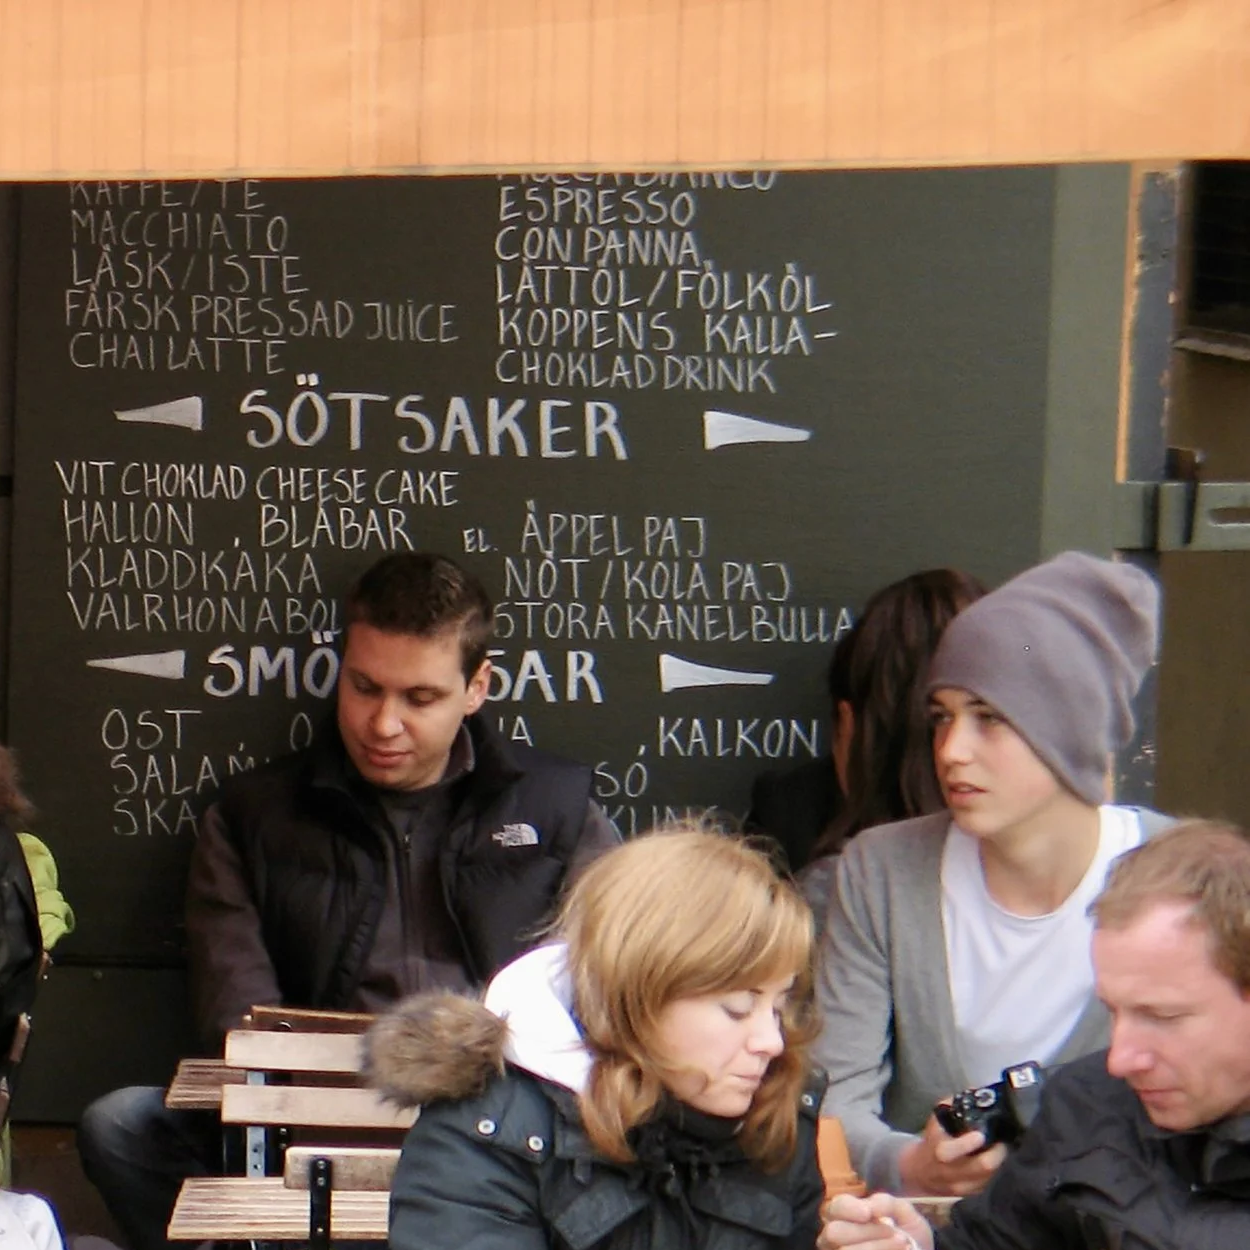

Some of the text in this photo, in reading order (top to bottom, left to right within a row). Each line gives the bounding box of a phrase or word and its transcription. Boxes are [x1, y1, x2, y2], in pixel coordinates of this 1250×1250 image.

[498, 187, 697, 226] ESPRESSO
[71, 209, 289, 253] MACCHIATO
[495, 226, 704, 268] CON PANNA
[191, 294, 355, 340] PRESSAD
[497, 307, 677, 351] KOPPENS
[69, 331, 289, 375] CHAI LATTE
[239, 373, 630, 462] SÖTSAKER
[54, 460, 116, 497] VIT
[121, 462, 247, 501] CHOKLAD
[62, 499, 195, 547] HALLON
[644, 516, 707, 559] PAJ
[722, 561, 791, 602] PAJ
[66, 592, 344, 635] VALRHONABOL
[492, 602, 855, 643] STORA KANELBULLA
[101, 708, 203, 751] OST
[657, 715, 819, 758] KALKON
